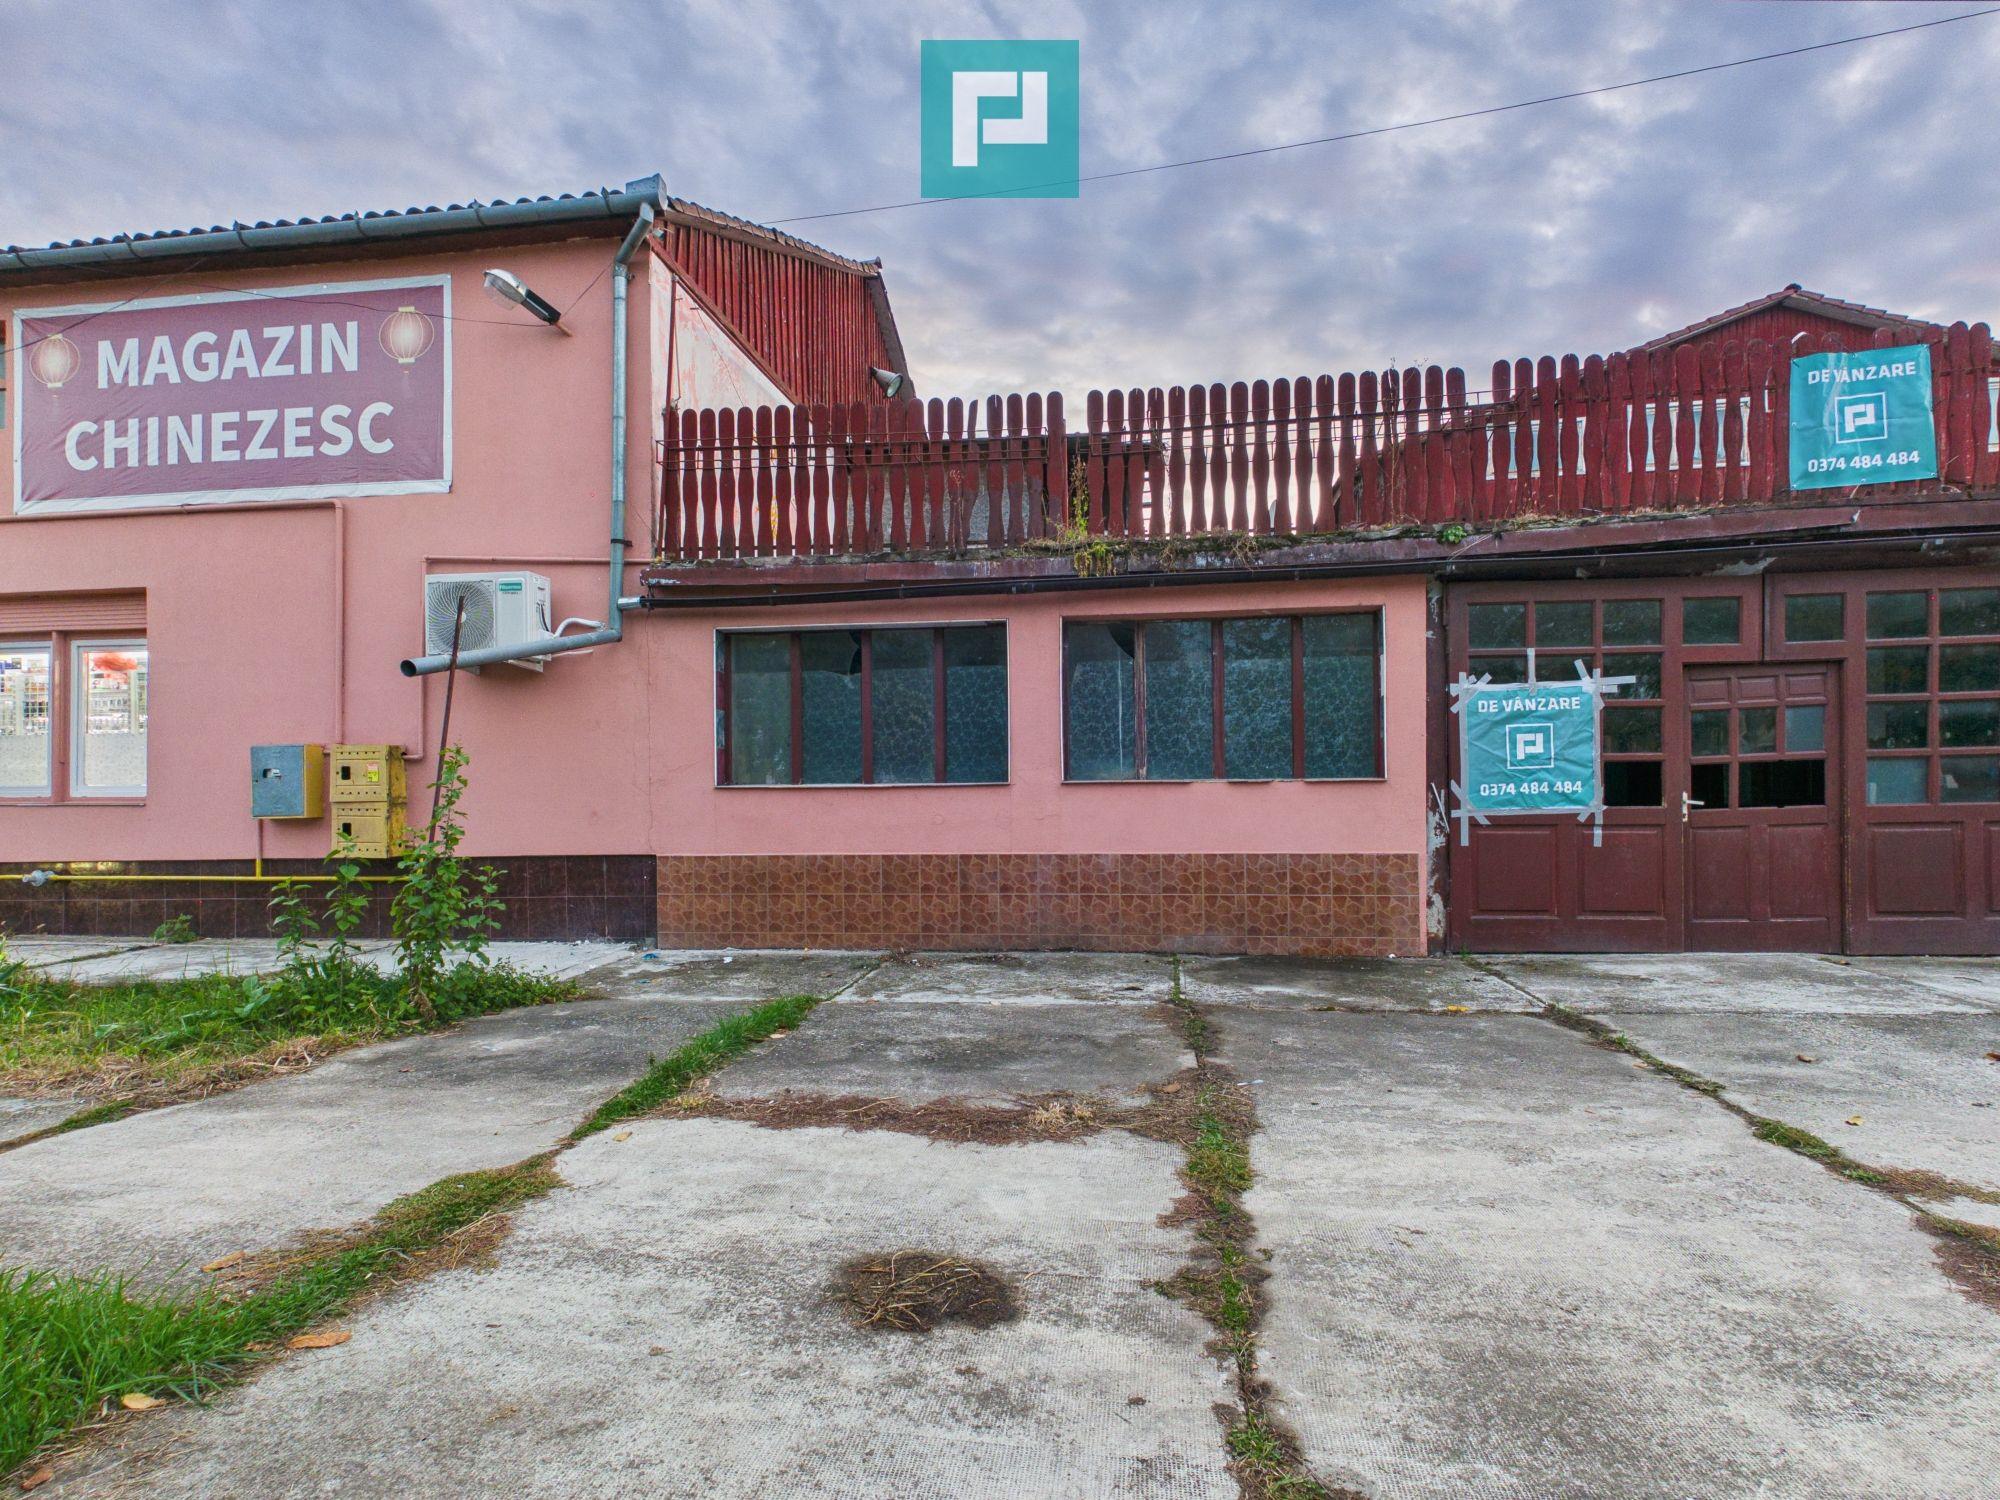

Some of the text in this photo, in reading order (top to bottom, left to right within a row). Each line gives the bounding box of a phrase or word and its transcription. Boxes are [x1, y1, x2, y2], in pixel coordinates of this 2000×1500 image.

[97, 321, 359, 389] MAGAZIN
[1808, 369, 1830, 385] DE
[65, 402, 394, 471] CHINEZESC
[1808, 450, 1920, 473] 0374 484 484
[1478, 696, 1581, 713] DE VÂNZARE
[1480, 781, 1583, 796] 0374 484 484
